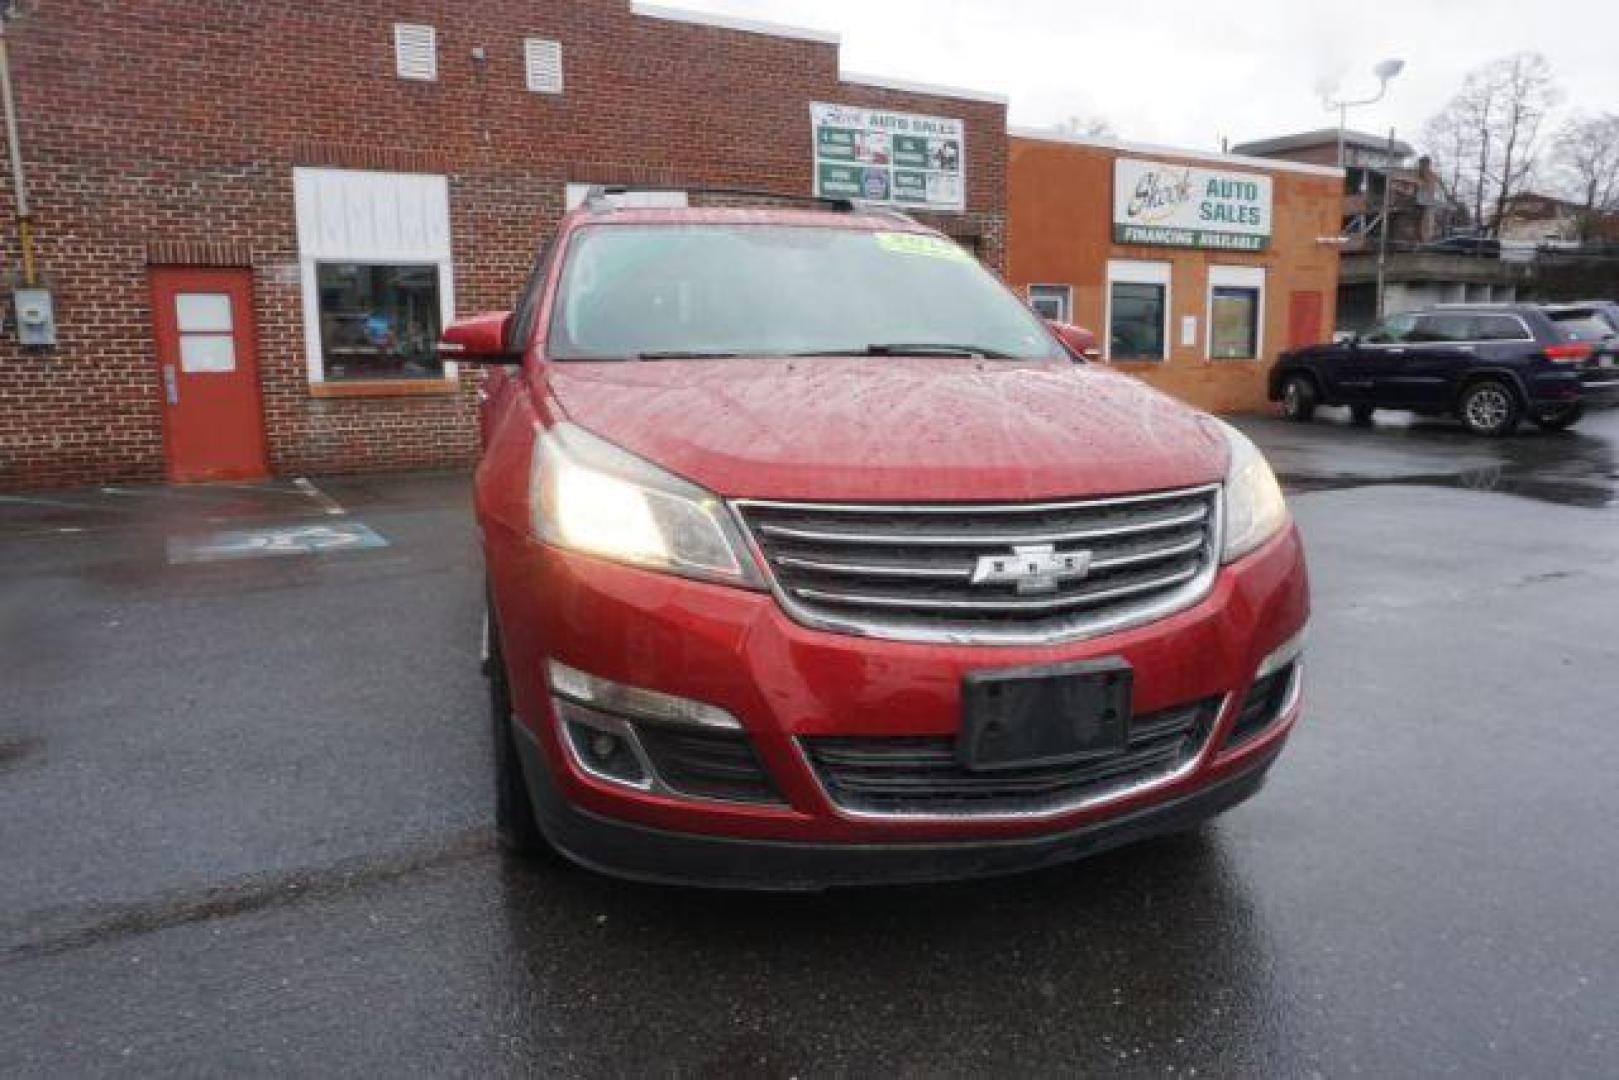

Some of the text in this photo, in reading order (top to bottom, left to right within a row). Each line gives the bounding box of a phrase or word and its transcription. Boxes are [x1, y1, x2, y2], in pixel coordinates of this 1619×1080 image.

[869, 114, 908, 130] AUTO
[912, 119, 956, 135] SALES
[1206, 178, 1258, 201] AUTO
[1198, 201, 1261, 226] SALES
[1125, 226, 1262, 249] FINANCING AVAILABLE
